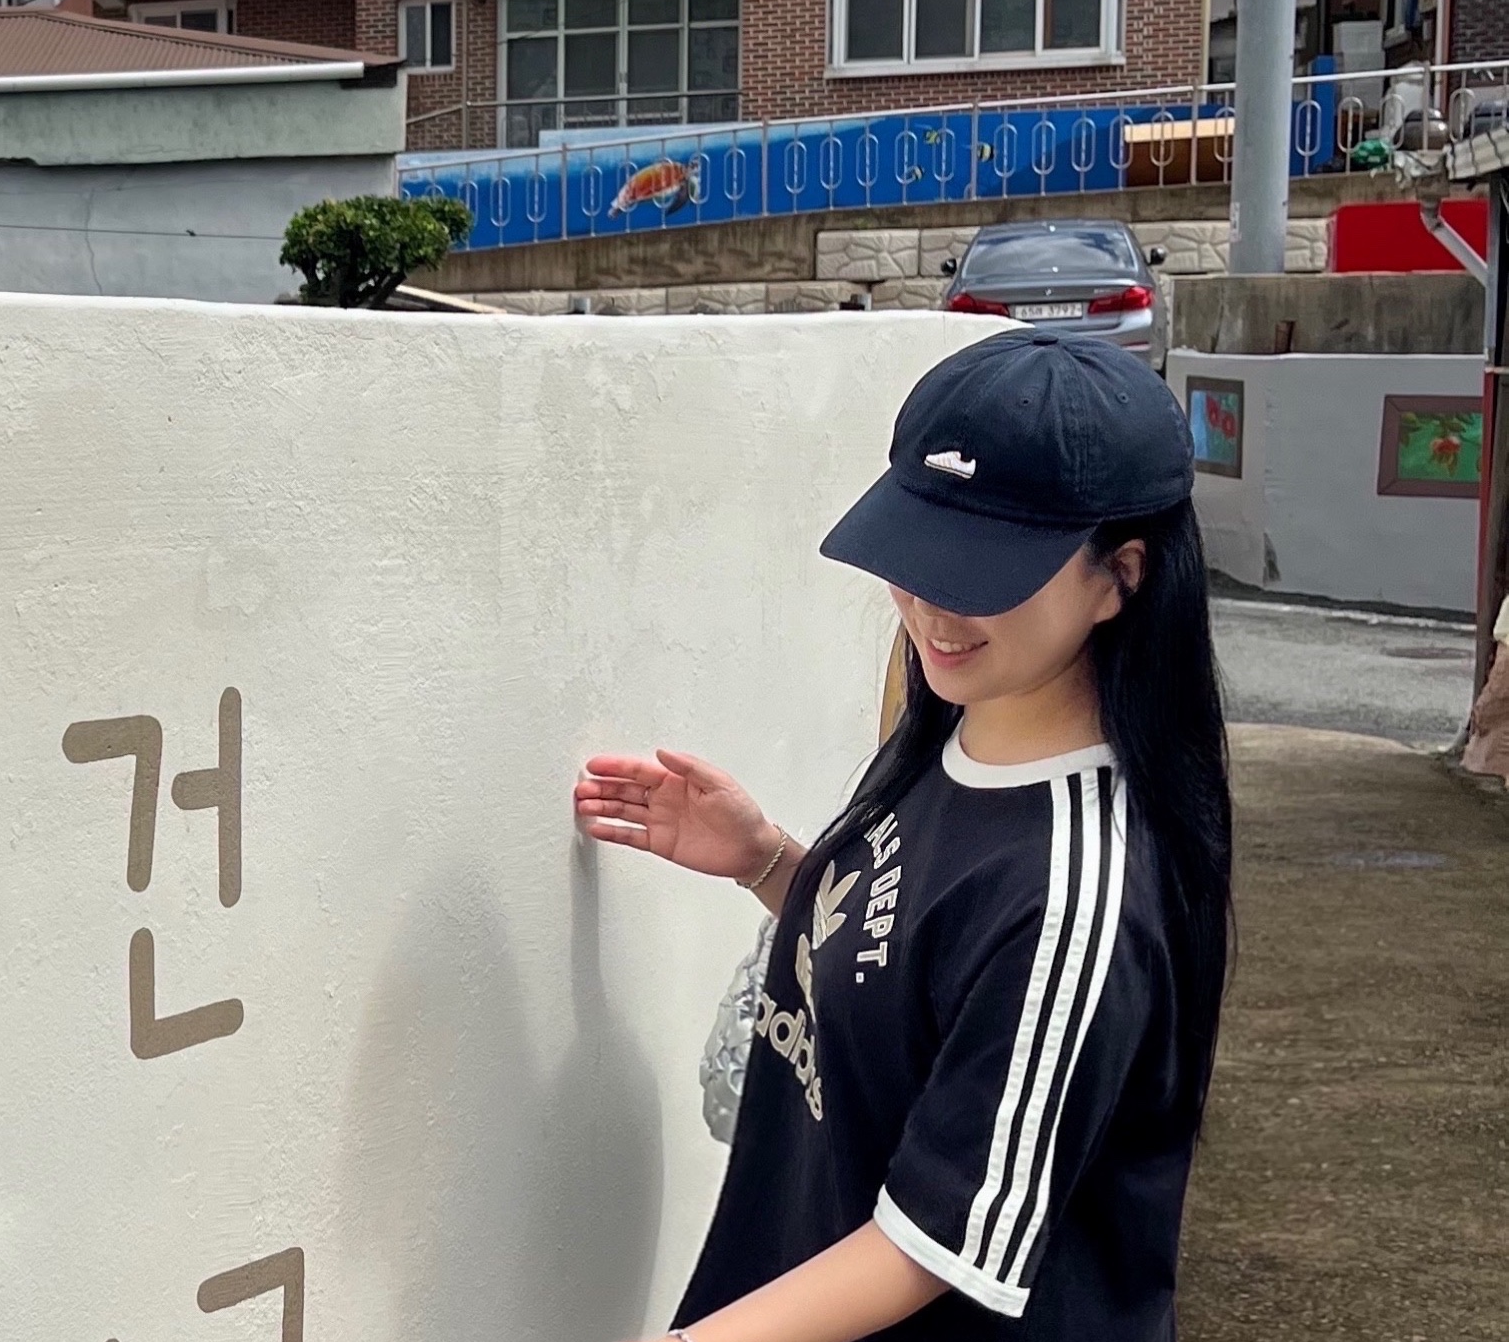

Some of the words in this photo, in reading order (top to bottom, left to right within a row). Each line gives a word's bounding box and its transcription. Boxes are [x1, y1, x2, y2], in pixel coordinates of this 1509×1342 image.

[61, 686, 245, 1060] 건
[864, 811, 901, 870] ALS
[855, 865, 902, 983] DEPT.
[755, 992, 823, 1122] adidas
